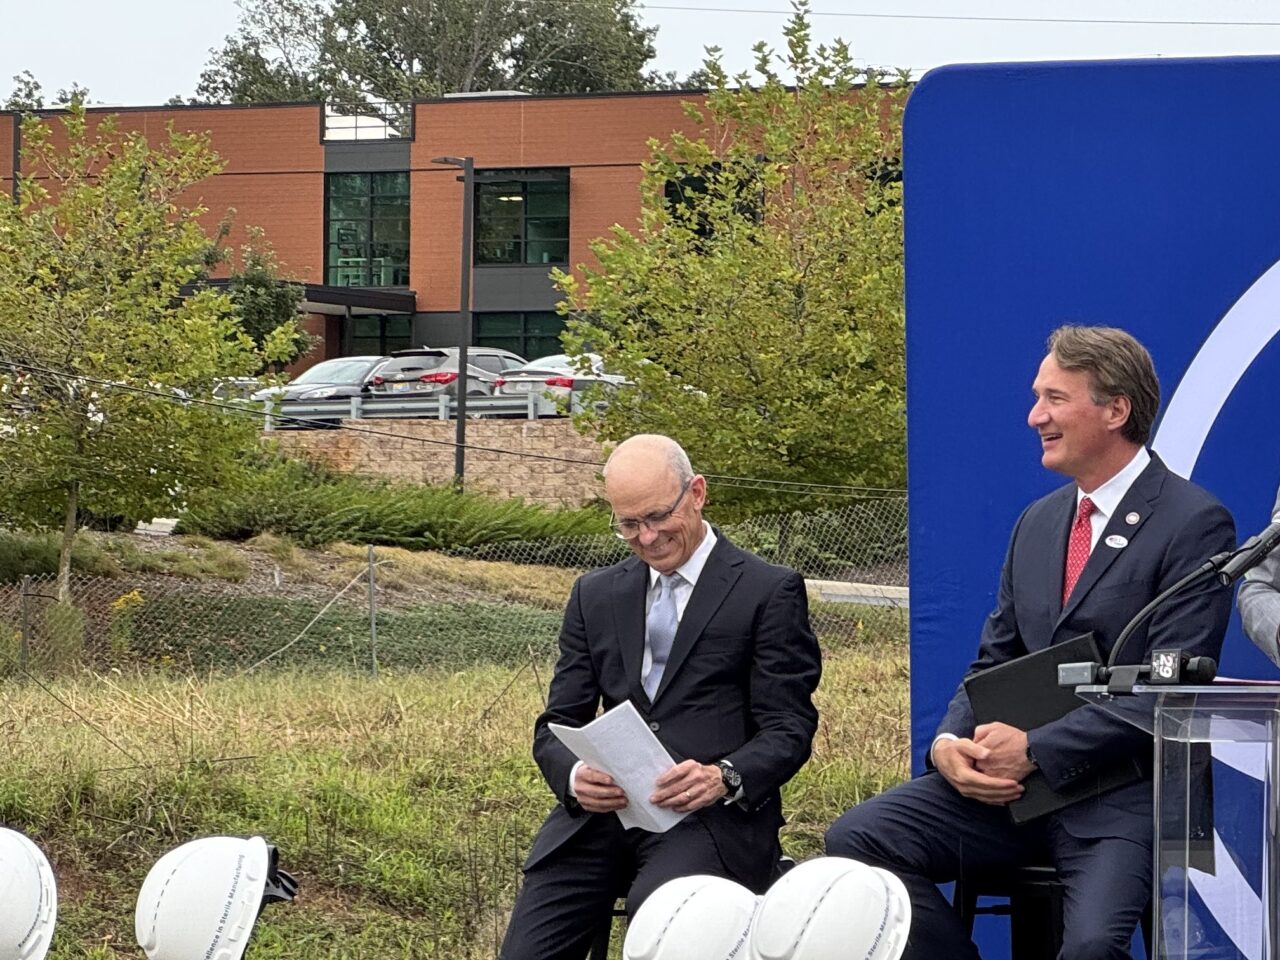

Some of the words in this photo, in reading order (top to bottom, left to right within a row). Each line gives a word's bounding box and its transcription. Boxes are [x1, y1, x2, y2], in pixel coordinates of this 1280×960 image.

[1160, 654, 1173, 678] 29
[220, 901, 232, 924] Sterile
[728, 938, 745, 958] Sterile
[867, 932, 882, 956] Sterile
